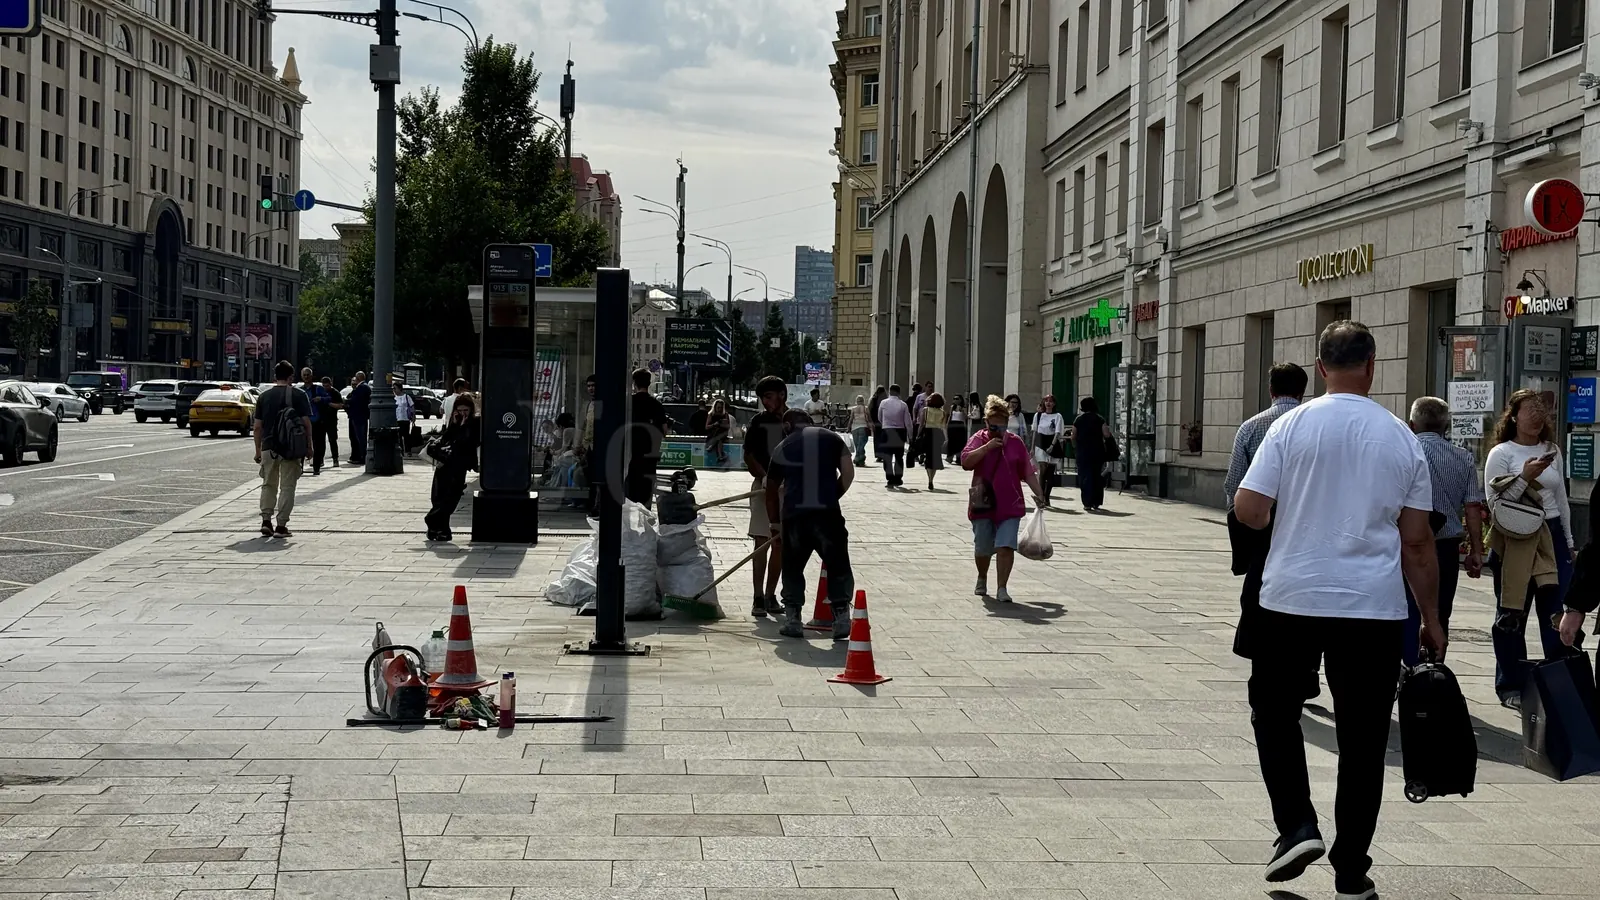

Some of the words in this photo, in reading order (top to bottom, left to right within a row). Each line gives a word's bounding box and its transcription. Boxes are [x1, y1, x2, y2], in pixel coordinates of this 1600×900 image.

[1306, 243, 1371, 283] COLLECTION
[492, 284, 506, 292] 913
[1526, 297, 1569, 316] Маркет
[670, 323, 706, 331] SHIFT
[1577, 385, 1593, 397] Coral
[1465, 400, 1486, 410] 550
[1460, 427, 1477, 436] 650
